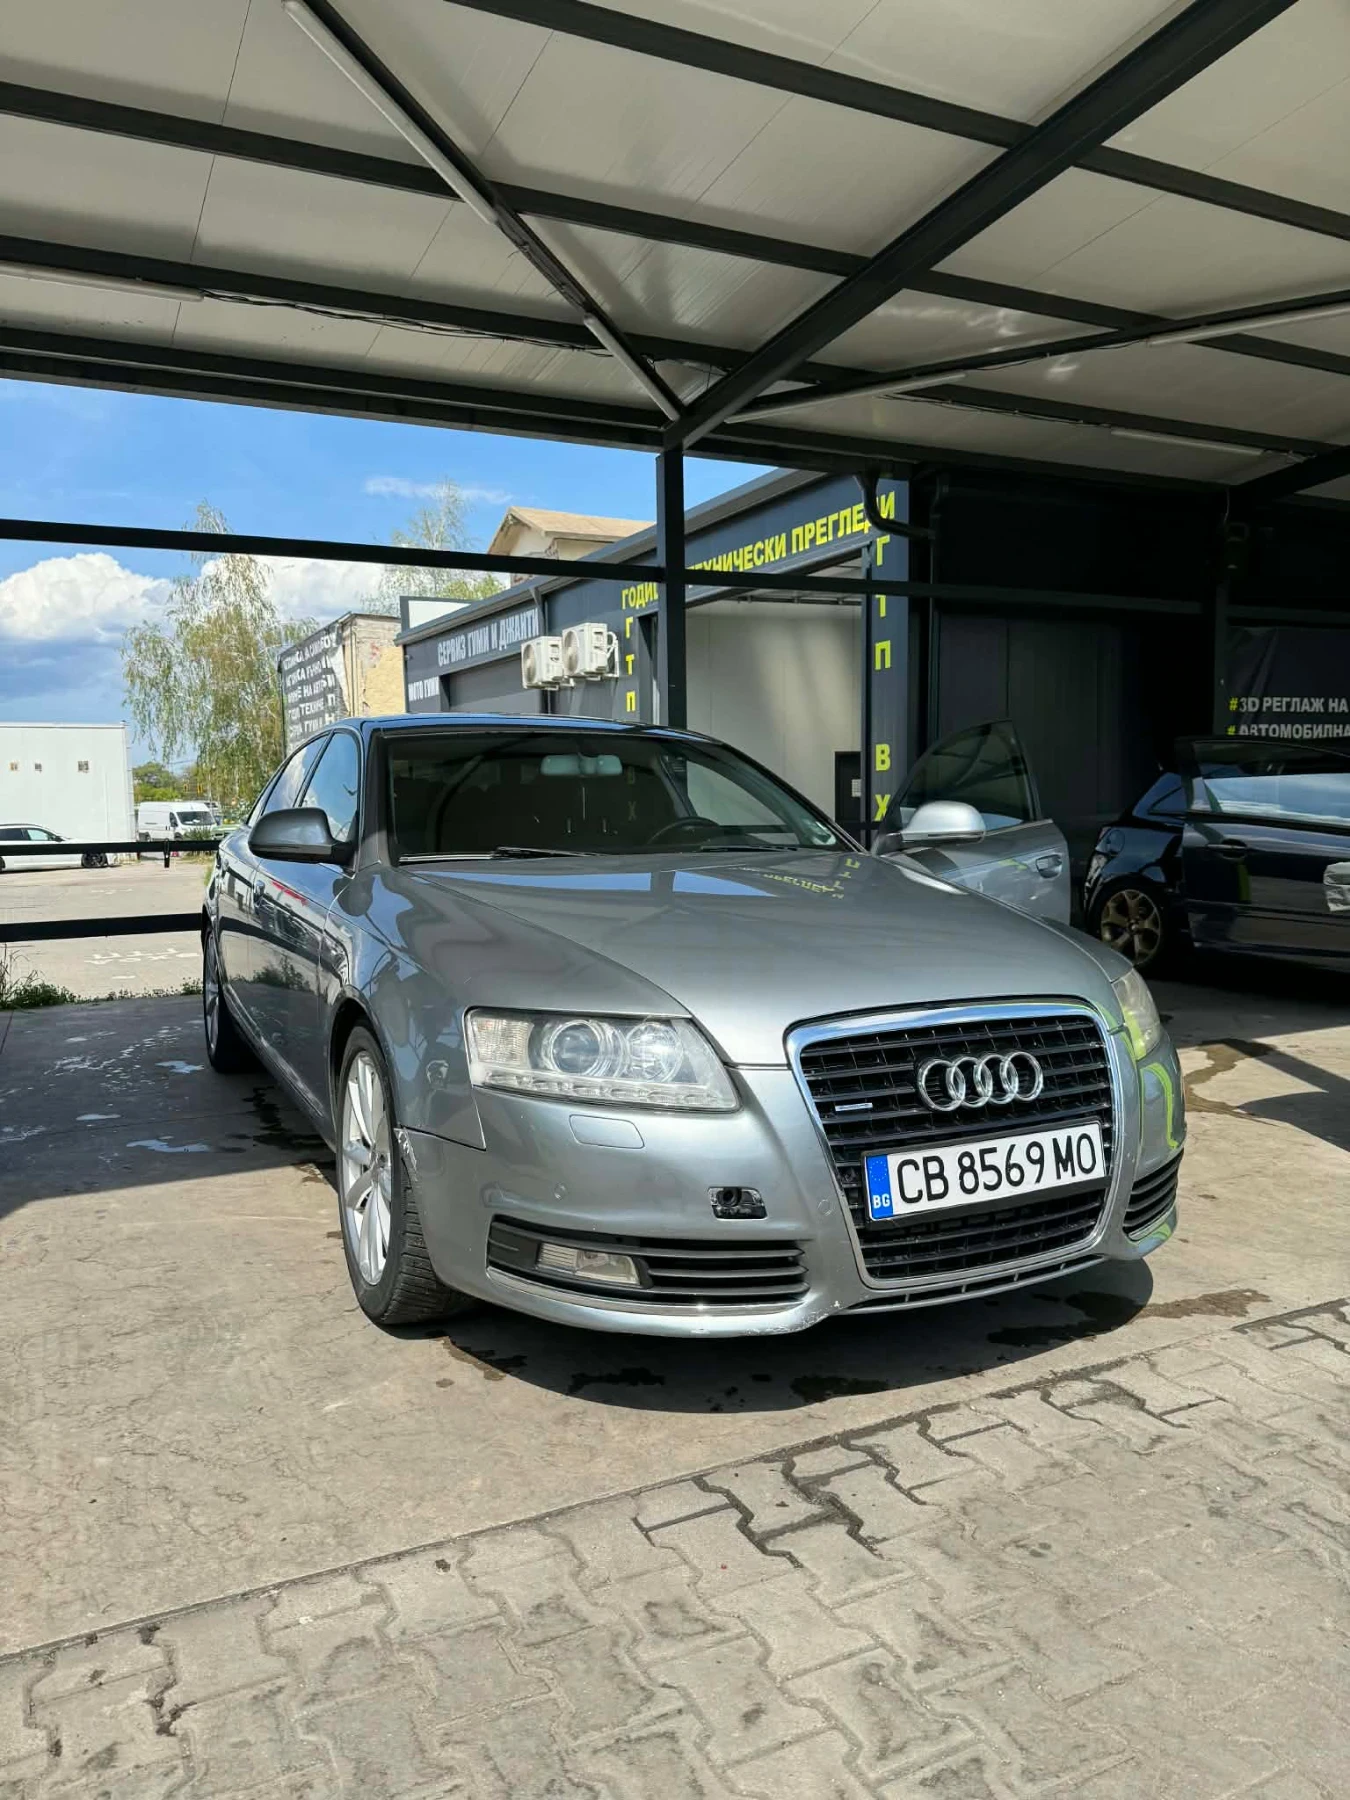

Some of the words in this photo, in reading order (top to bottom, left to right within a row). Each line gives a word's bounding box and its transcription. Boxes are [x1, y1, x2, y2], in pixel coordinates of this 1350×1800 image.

[1262, 697, 1325, 713] РЕГЛАЖ
[1328, 697, 1349, 713] НА
[896, 1155, 949, 1204] CB
[957, 1141, 1046, 1195] 8569
[1052, 1132, 1097, 1180] MO
[873, 1194, 891, 1209] BG
